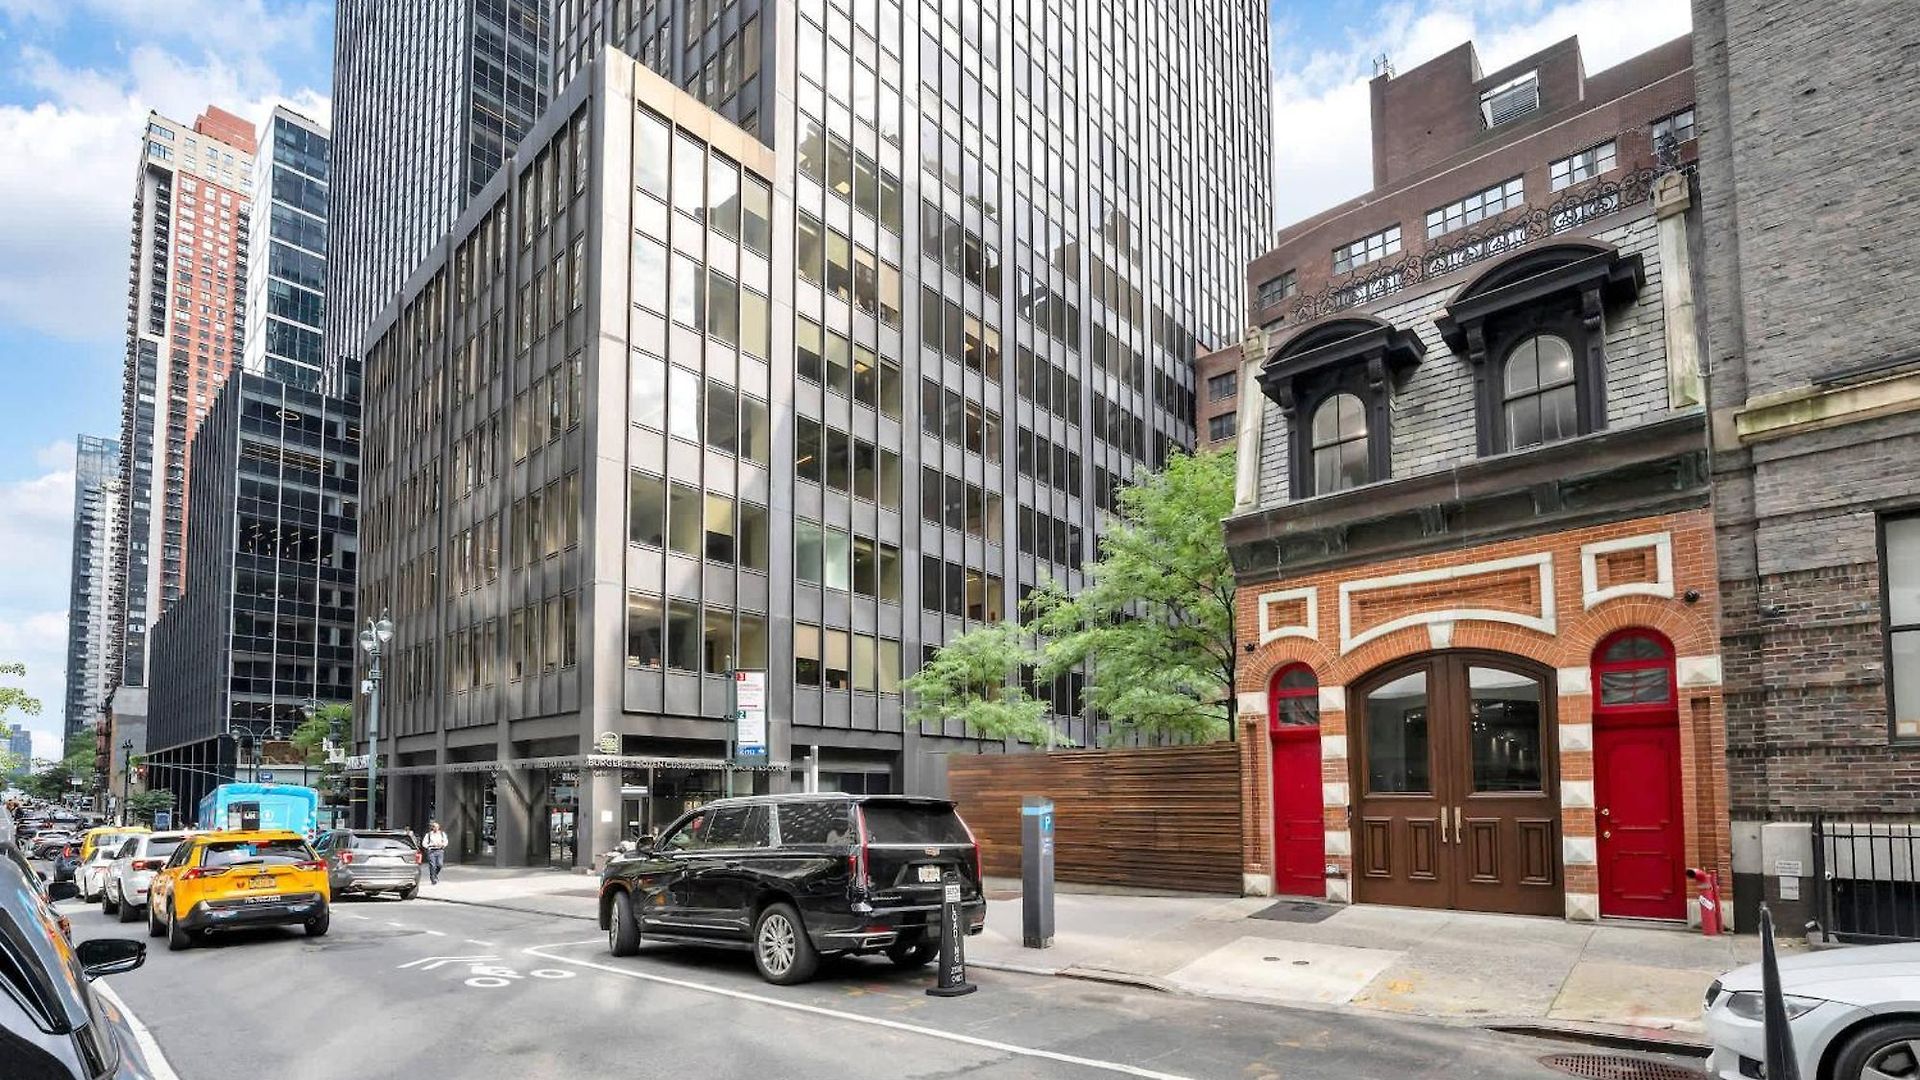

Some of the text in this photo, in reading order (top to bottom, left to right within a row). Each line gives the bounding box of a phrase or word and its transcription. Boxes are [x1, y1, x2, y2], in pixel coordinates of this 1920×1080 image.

[588, 758, 628, 768] BURGERS
[633, 760, 663, 769] FROZEN
[1045, 816, 1051, 830] P
[951, 904, 960, 964] LOADING
